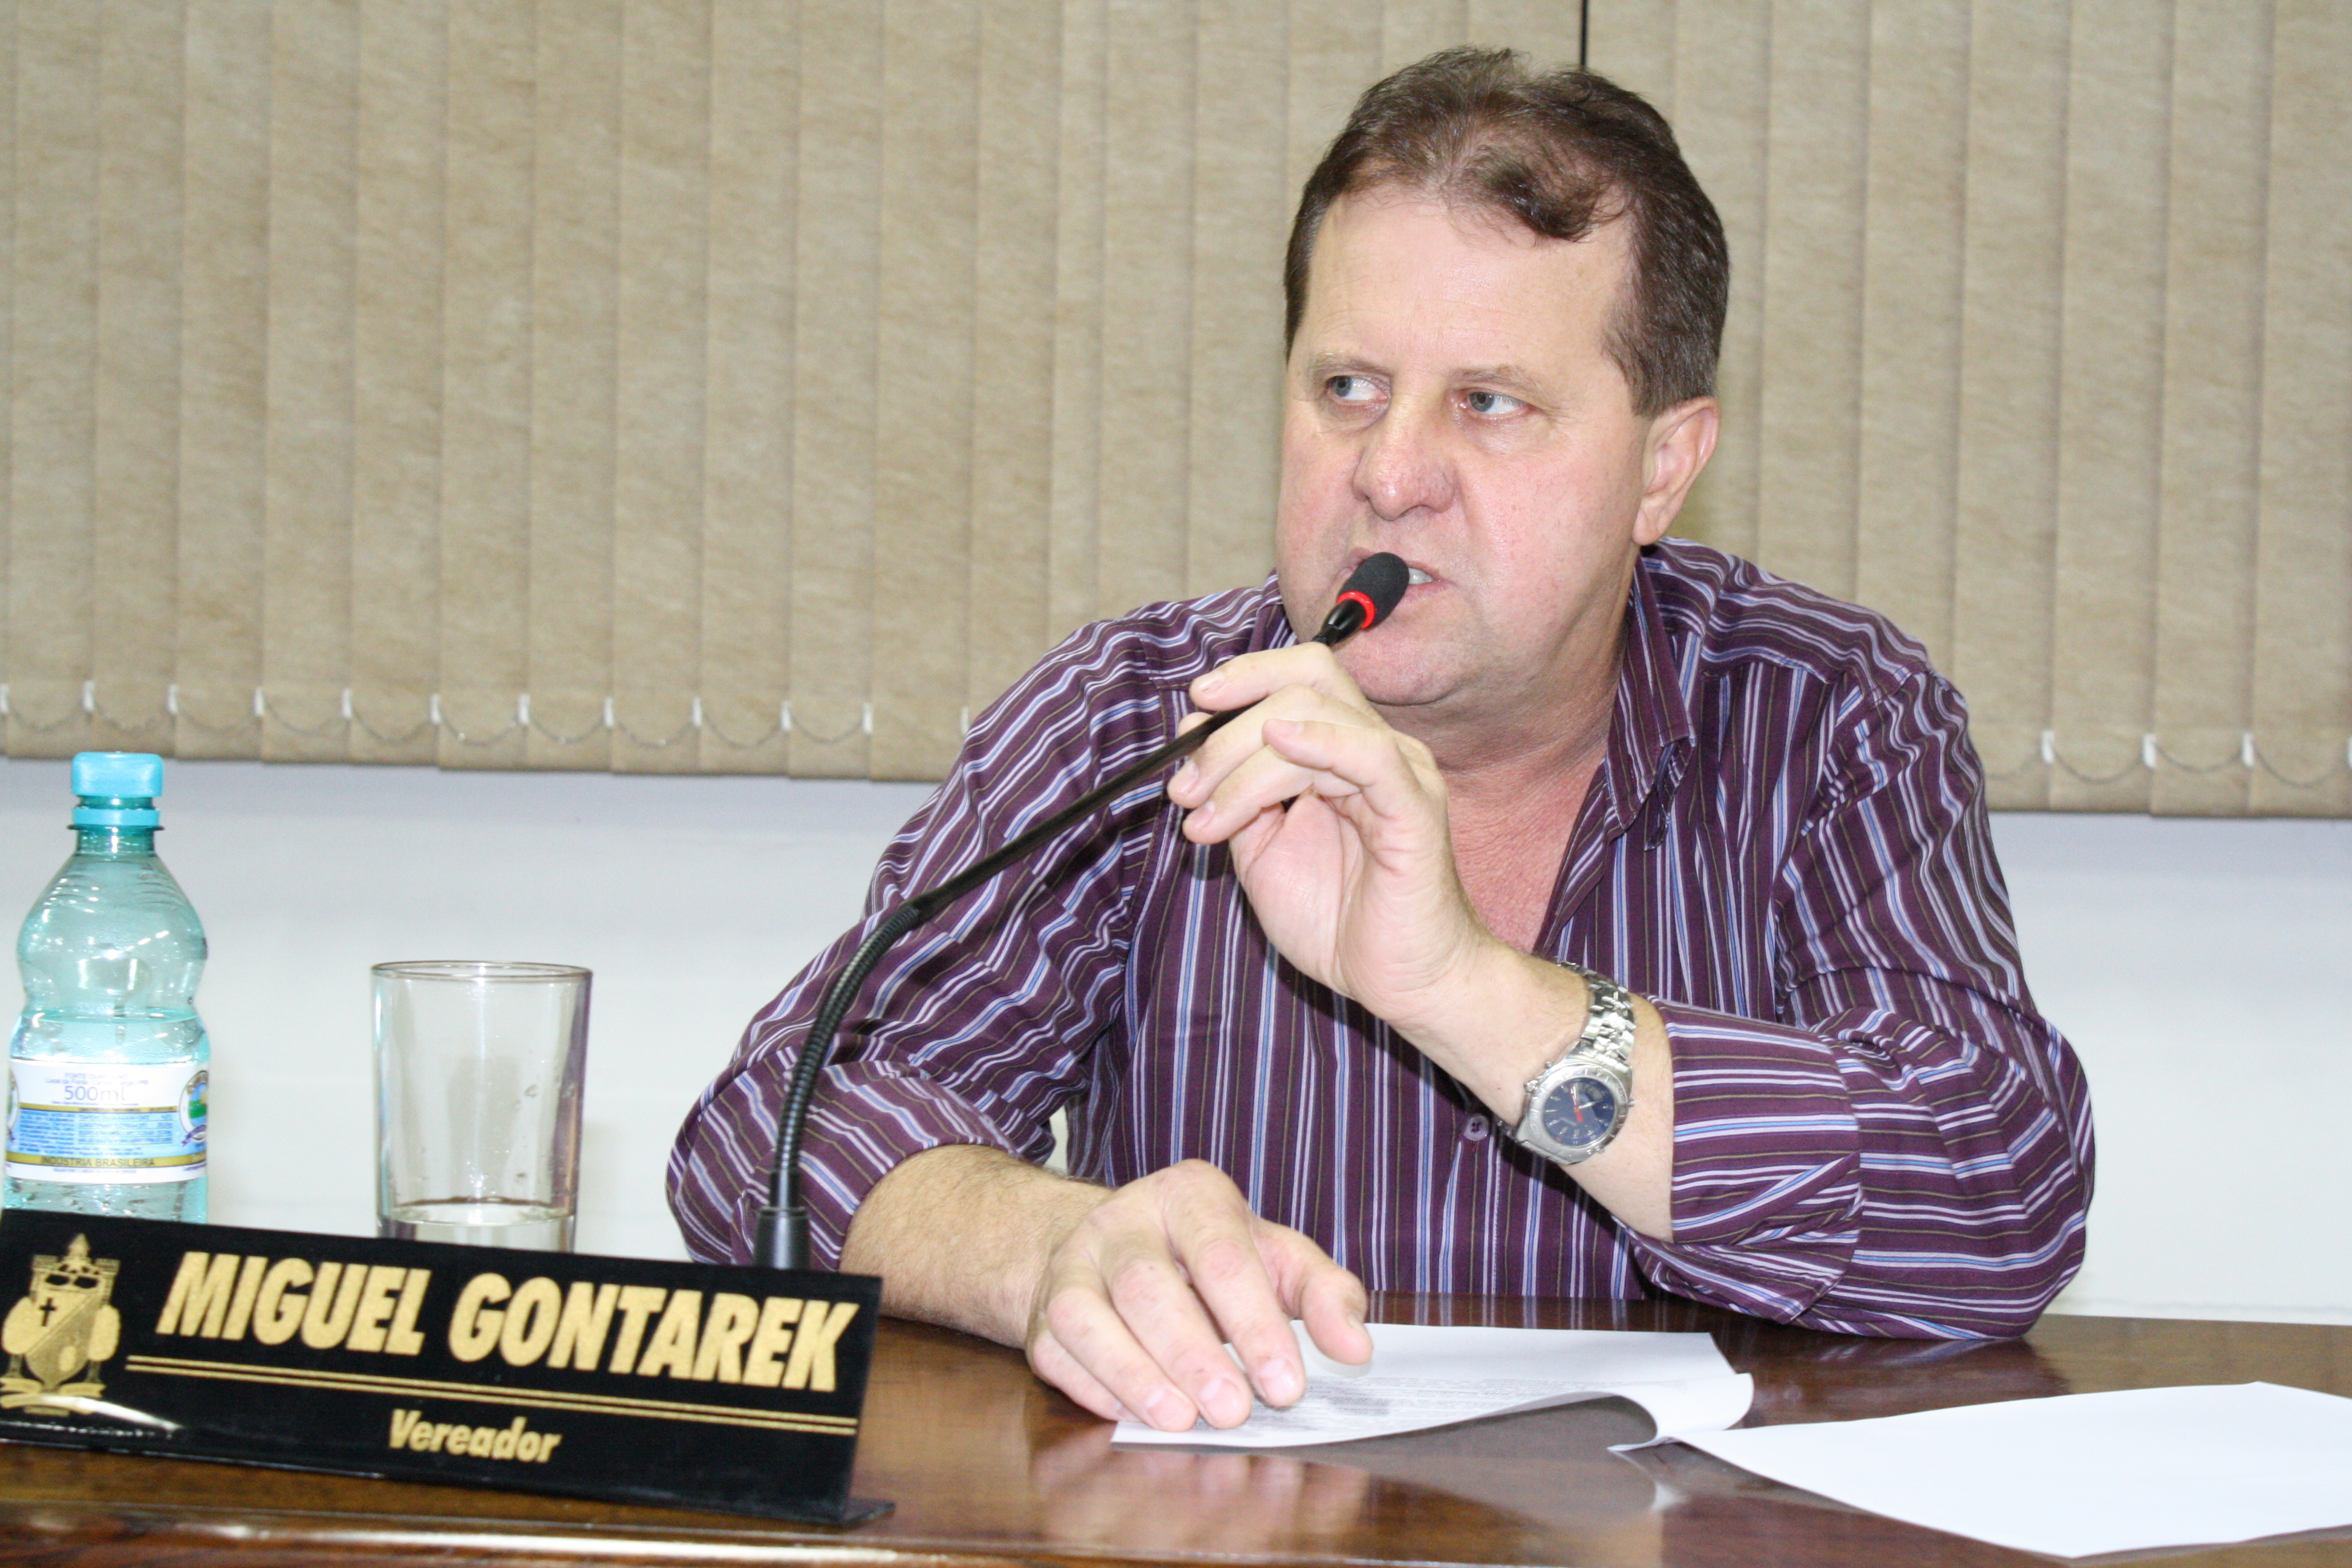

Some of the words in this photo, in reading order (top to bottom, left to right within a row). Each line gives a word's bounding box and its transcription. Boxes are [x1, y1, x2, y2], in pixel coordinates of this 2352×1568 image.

[156, 1251, 431, 1356] MIGUEL
[448, 1273, 859, 1392] GONTAREK
[390, 1409, 561, 1463] Vereador
